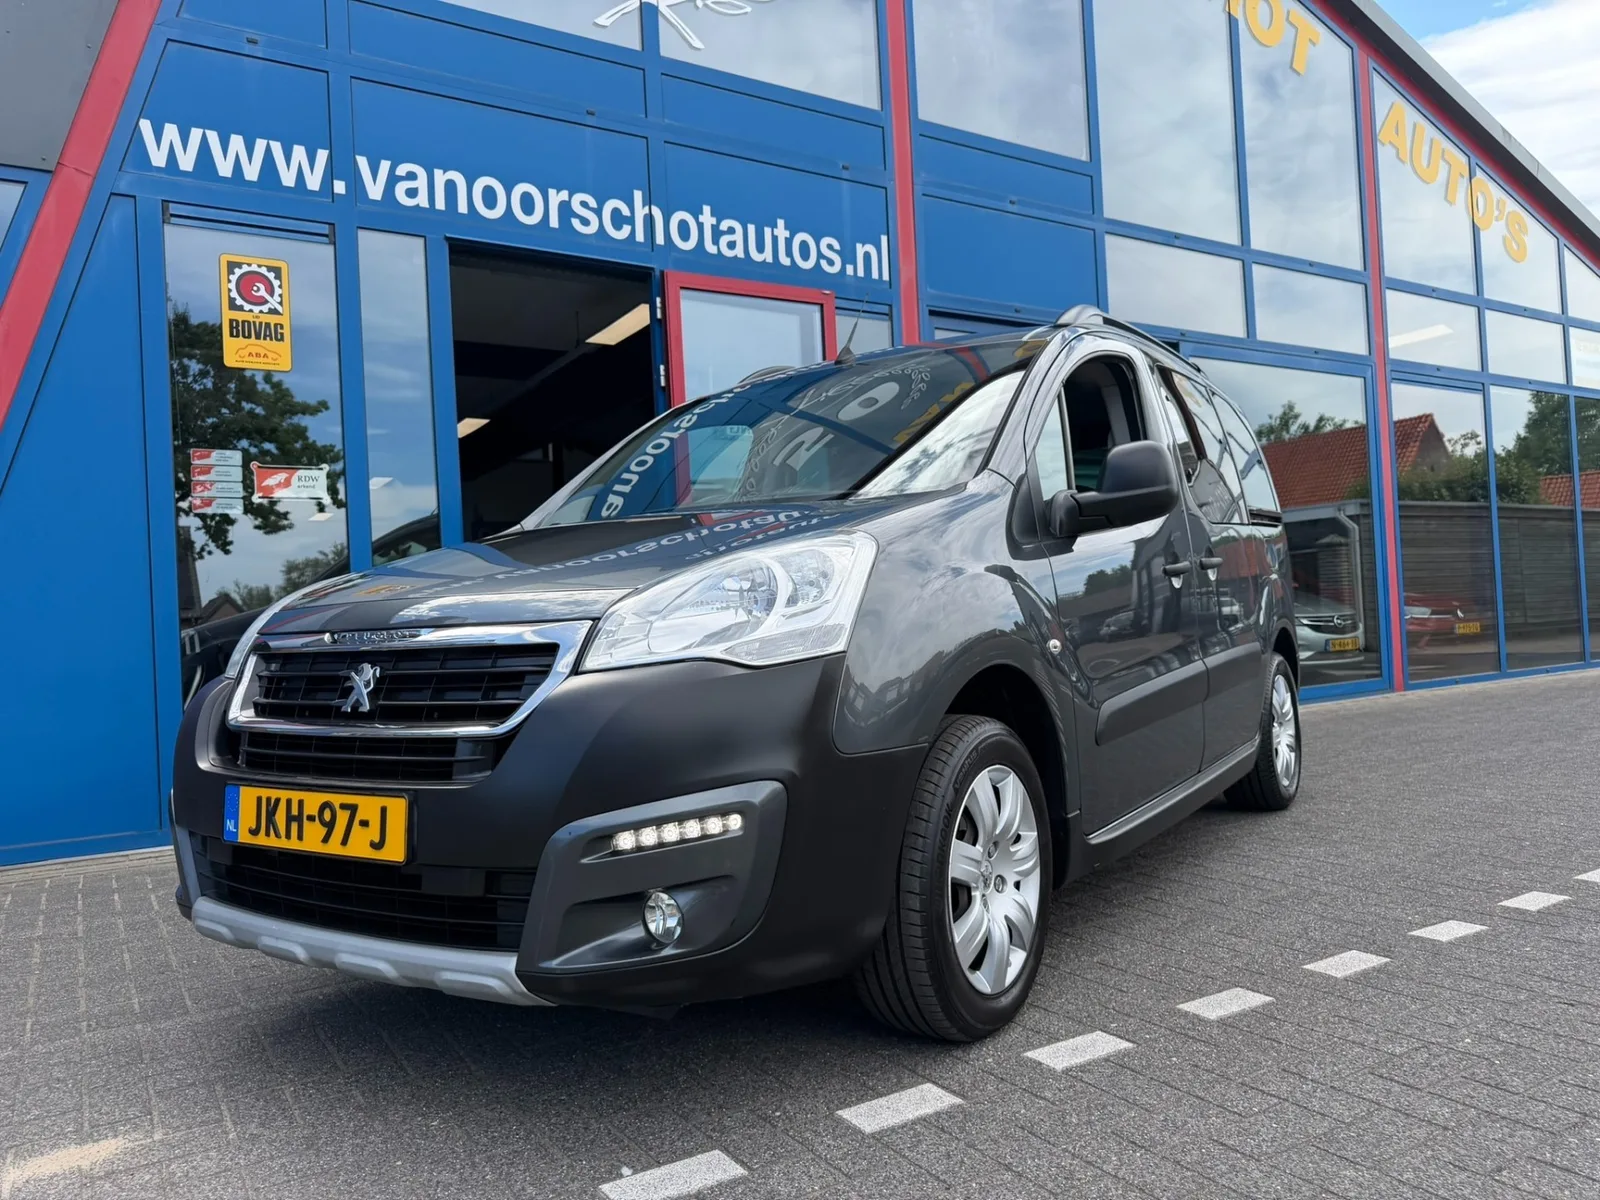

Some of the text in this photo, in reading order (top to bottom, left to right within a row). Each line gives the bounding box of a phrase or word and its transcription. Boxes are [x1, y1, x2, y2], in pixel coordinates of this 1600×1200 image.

[1223, 0, 1529, 263] OT AUTO'S
[139, 118, 890, 282] www.vanoorschotautos.nl
[228, 318, 285, 343] BOVAG
[247, 351, 269, 359] ABA
[297, 474, 320, 483] RDW
[226, 819, 237, 832] NL
[248, 795, 388, 851] JKH-97-J
